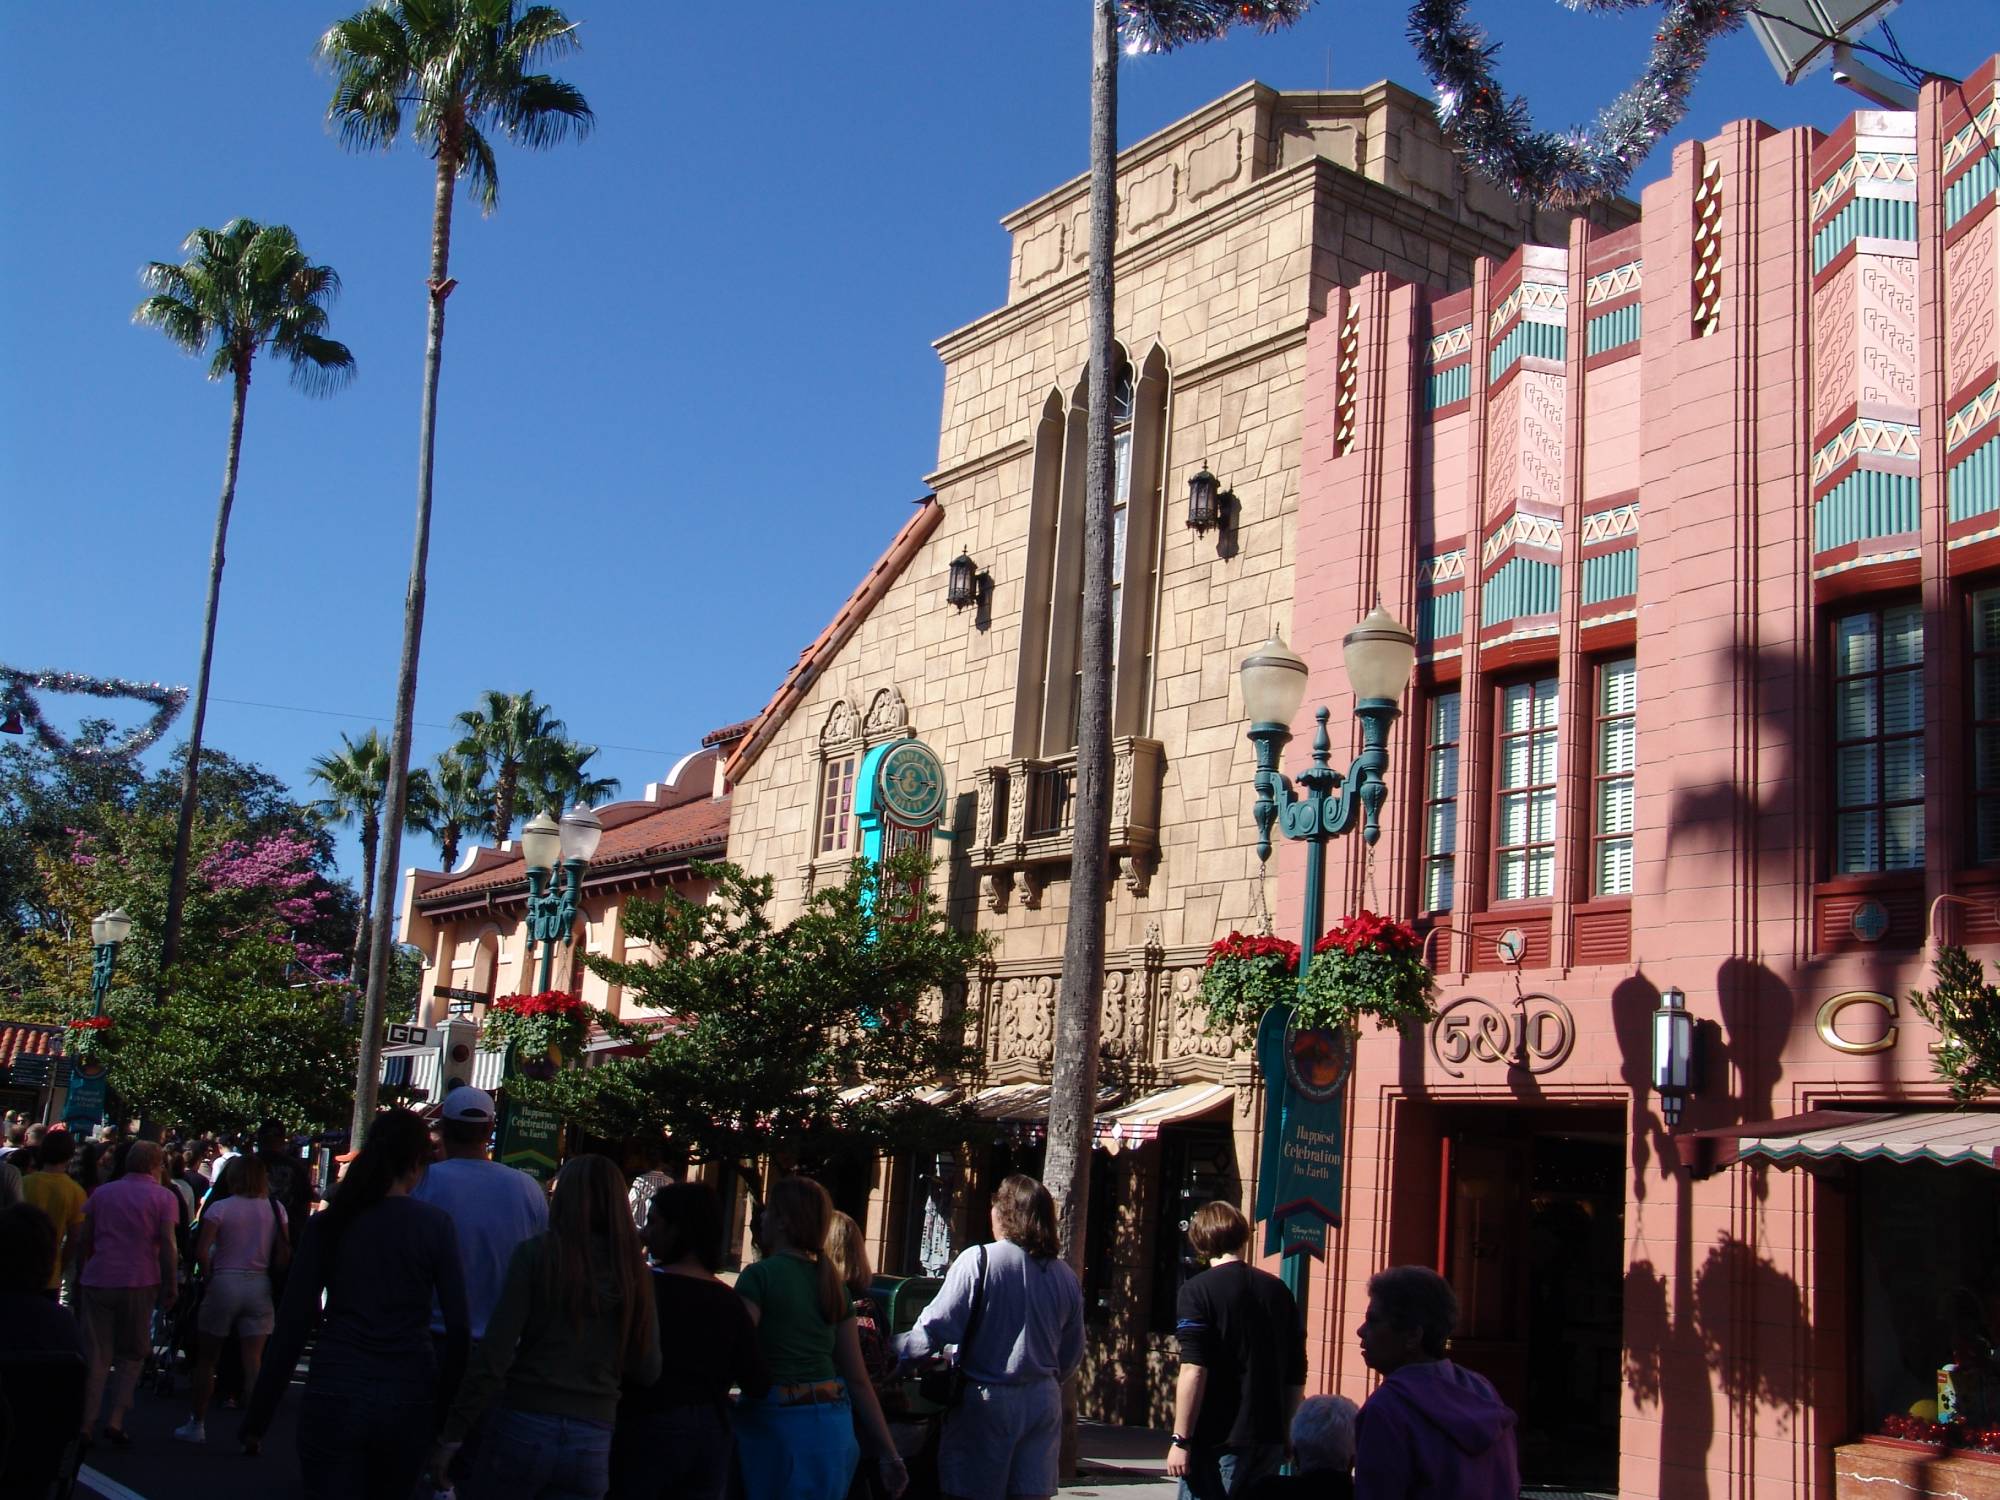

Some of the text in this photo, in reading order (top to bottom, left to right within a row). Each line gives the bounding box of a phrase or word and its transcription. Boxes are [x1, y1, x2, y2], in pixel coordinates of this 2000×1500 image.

[391, 1024, 427, 1046] GO
[1439, 1003, 1570, 1067] 5&10
[1296, 1125, 1335, 1145] Happiest
[1283, 1141, 1341, 1165] Celebration
[1294, 1163, 1329, 1180] On Earth
